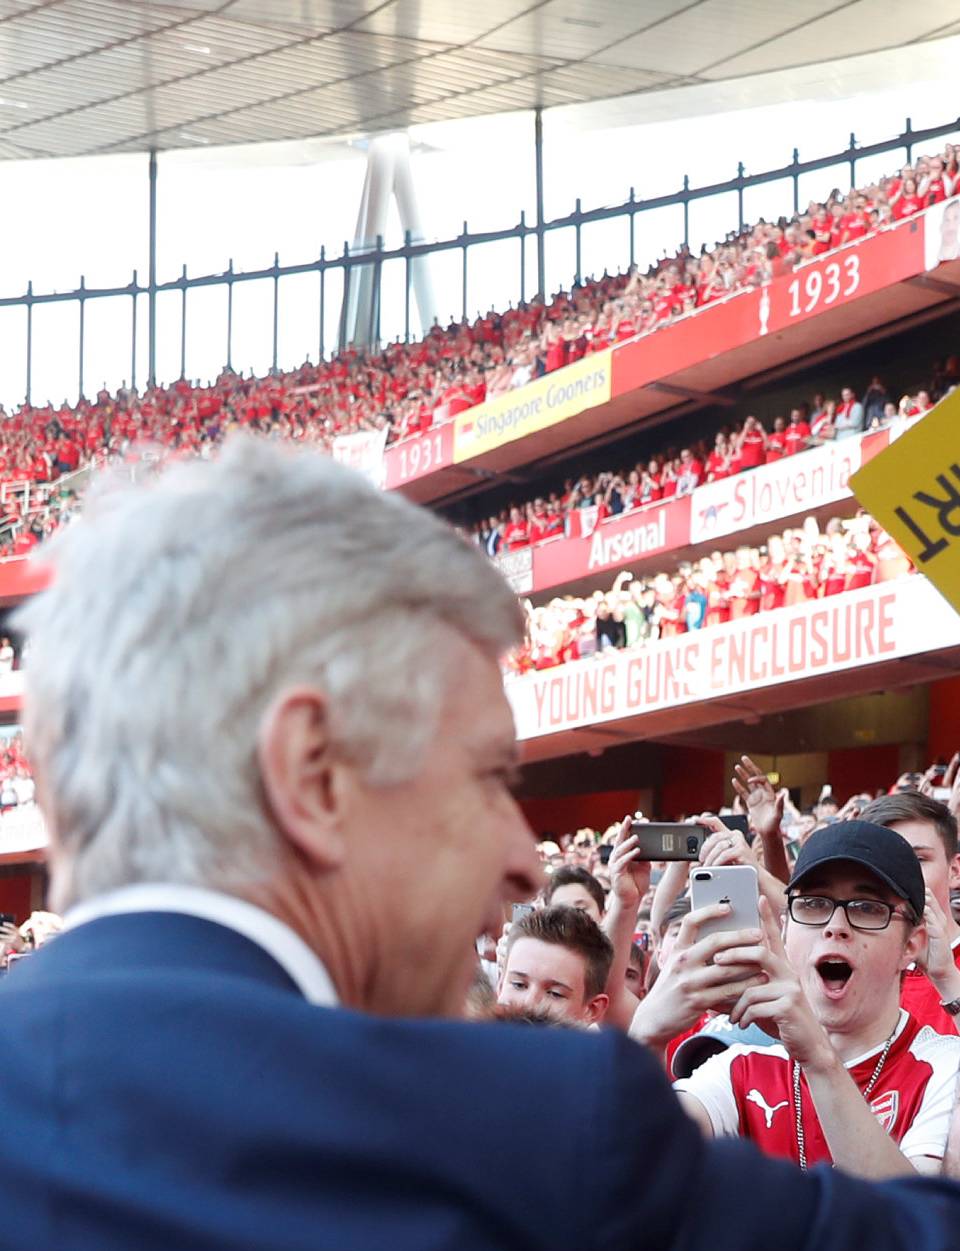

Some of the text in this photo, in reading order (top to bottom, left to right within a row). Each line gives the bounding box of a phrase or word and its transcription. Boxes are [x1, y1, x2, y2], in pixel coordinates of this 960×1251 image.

[788, 254, 860, 317] 1933
[475, 368, 606, 438] Singapore Gooners
[400, 434, 443, 478] 1931
[733, 450, 851, 522] Slovenia
[588, 510, 666, 570] Arsenal
[534, 593, 897, 728] YOUNG GUNS ENCLOSURE
